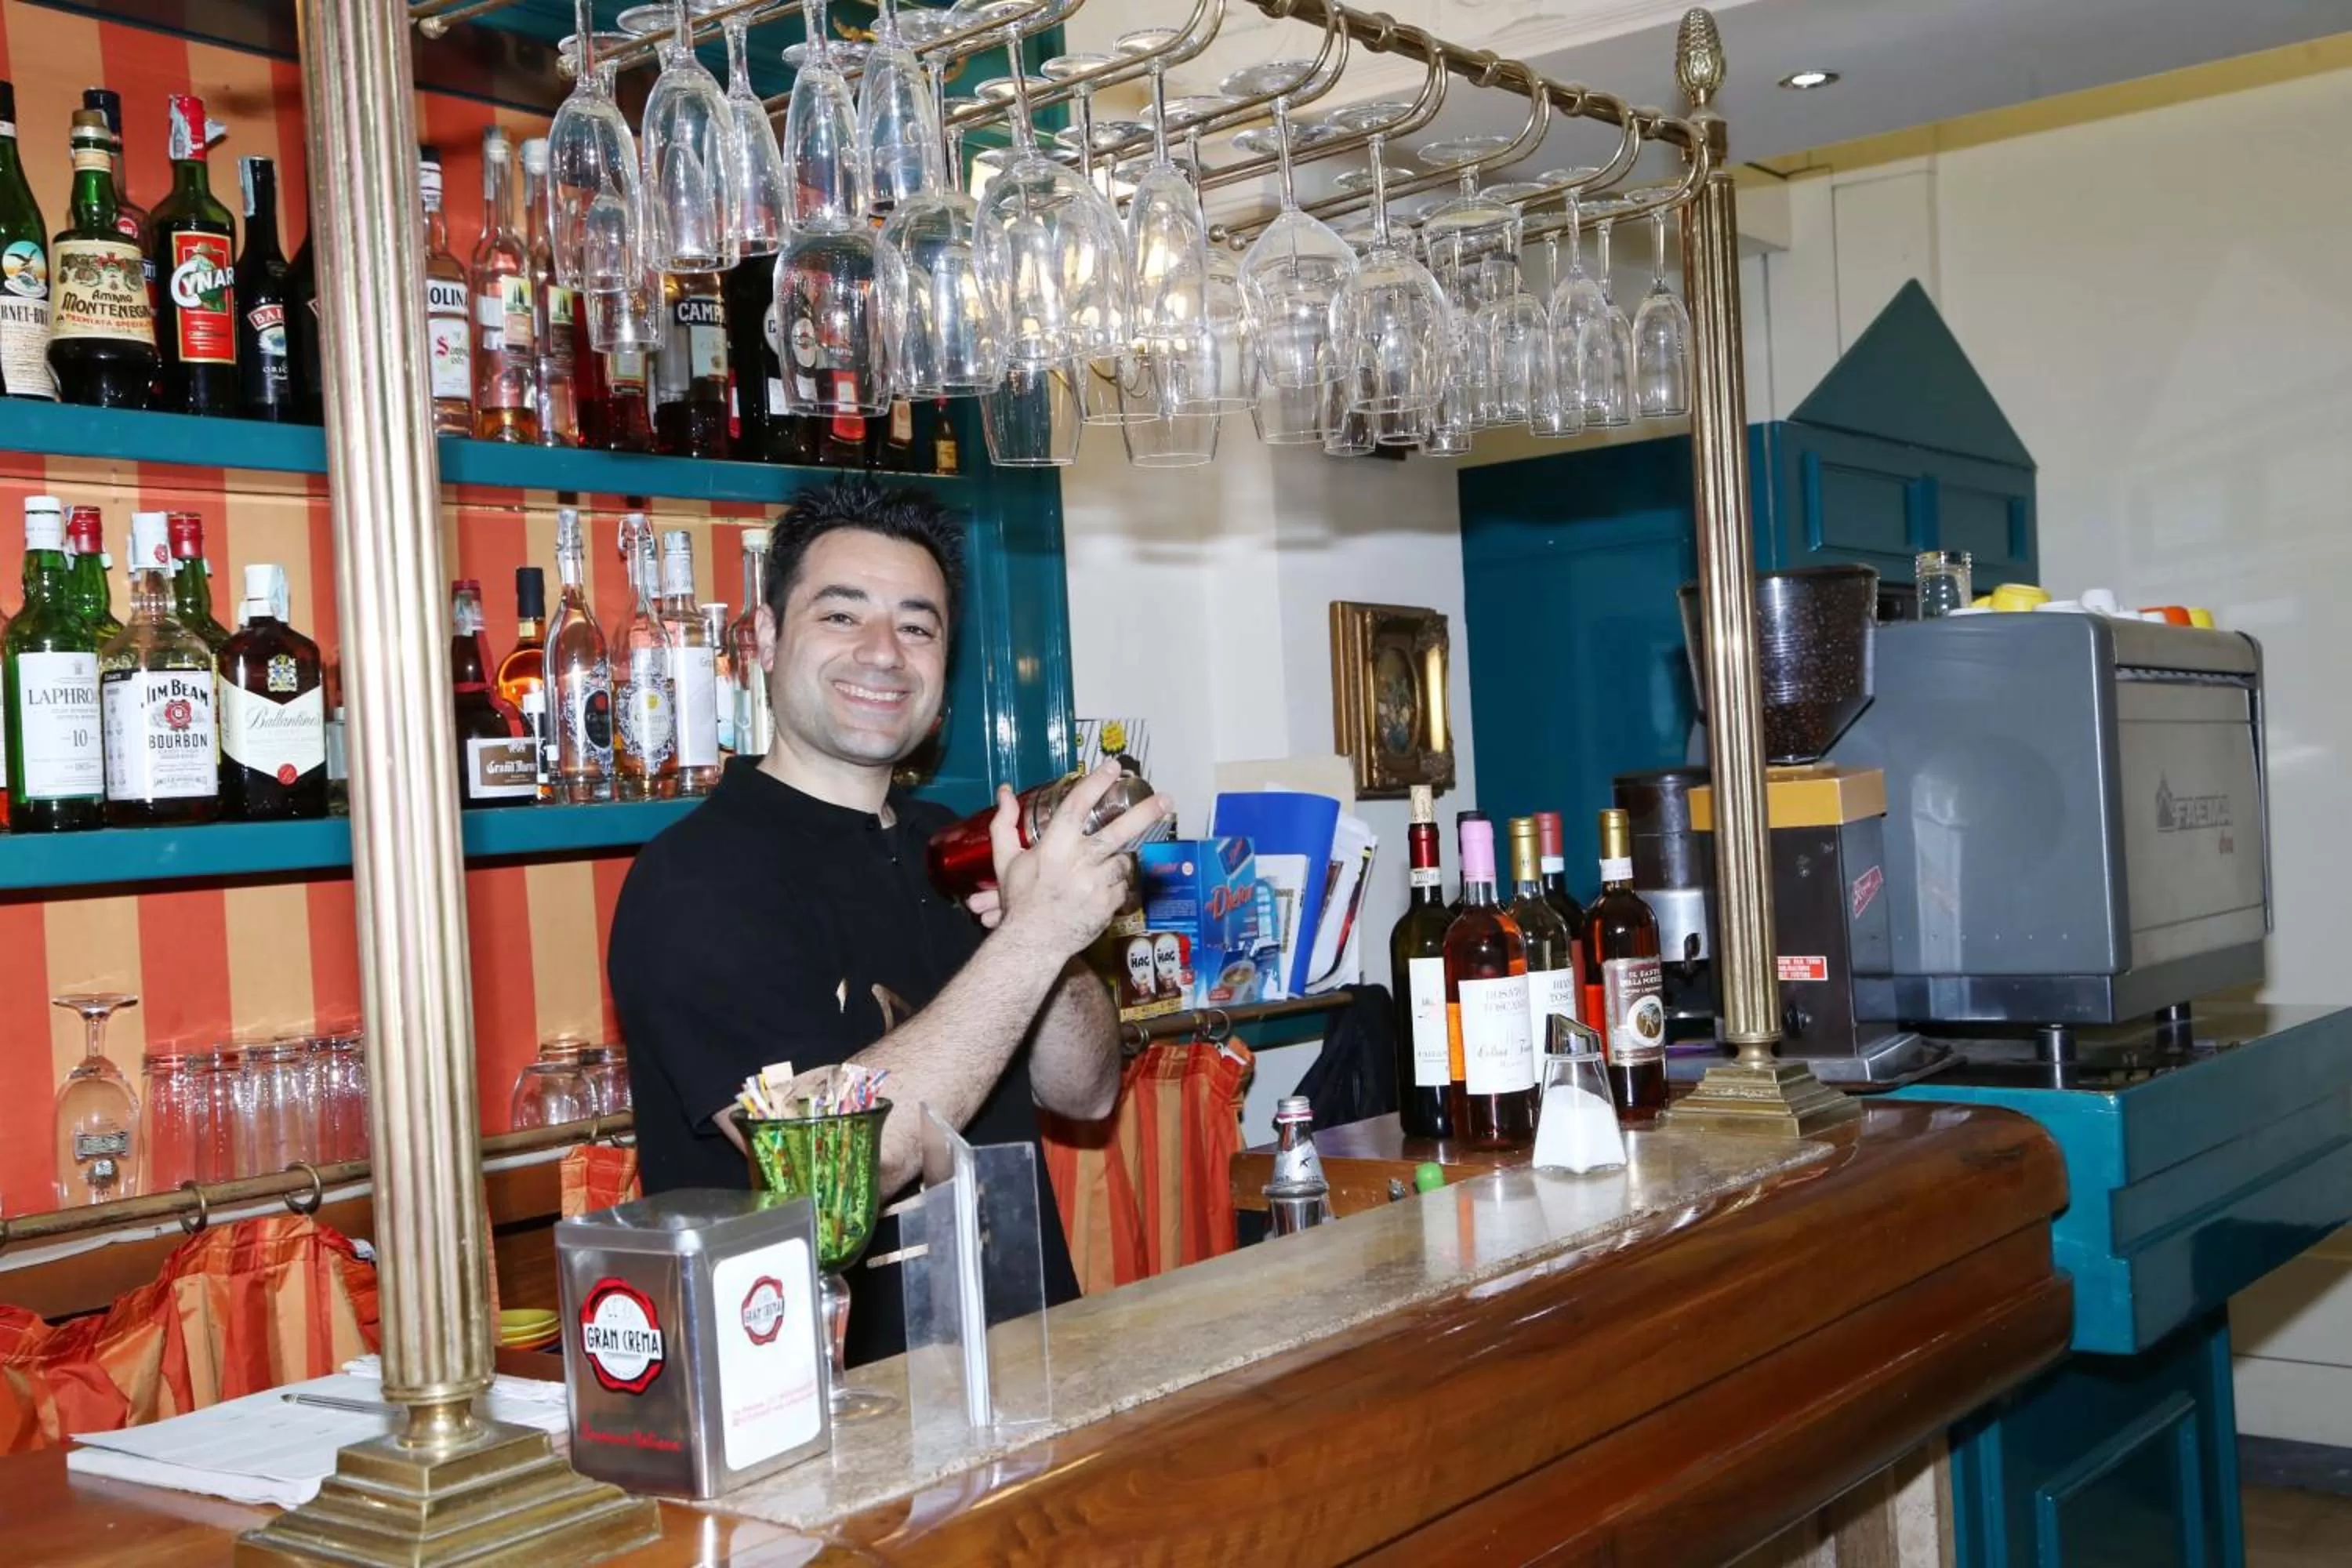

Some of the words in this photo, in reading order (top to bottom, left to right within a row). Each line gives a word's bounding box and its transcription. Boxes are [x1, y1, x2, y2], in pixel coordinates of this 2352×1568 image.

[170, 260, 234, 307] CYNAR
[62, 292, 151, 319] MONTENEGR
[428, 285, 468, 307] OLIN
[254, 307, 283, 325] BAI
[27, 687, 95, 706] LAPHRO
[171, 678, 209, 706] BEAM
[73, 729, 88, 747] 10
[148, 732, 208, 750] BOURBON
[622, 1330, 659, 1353] CREMA
